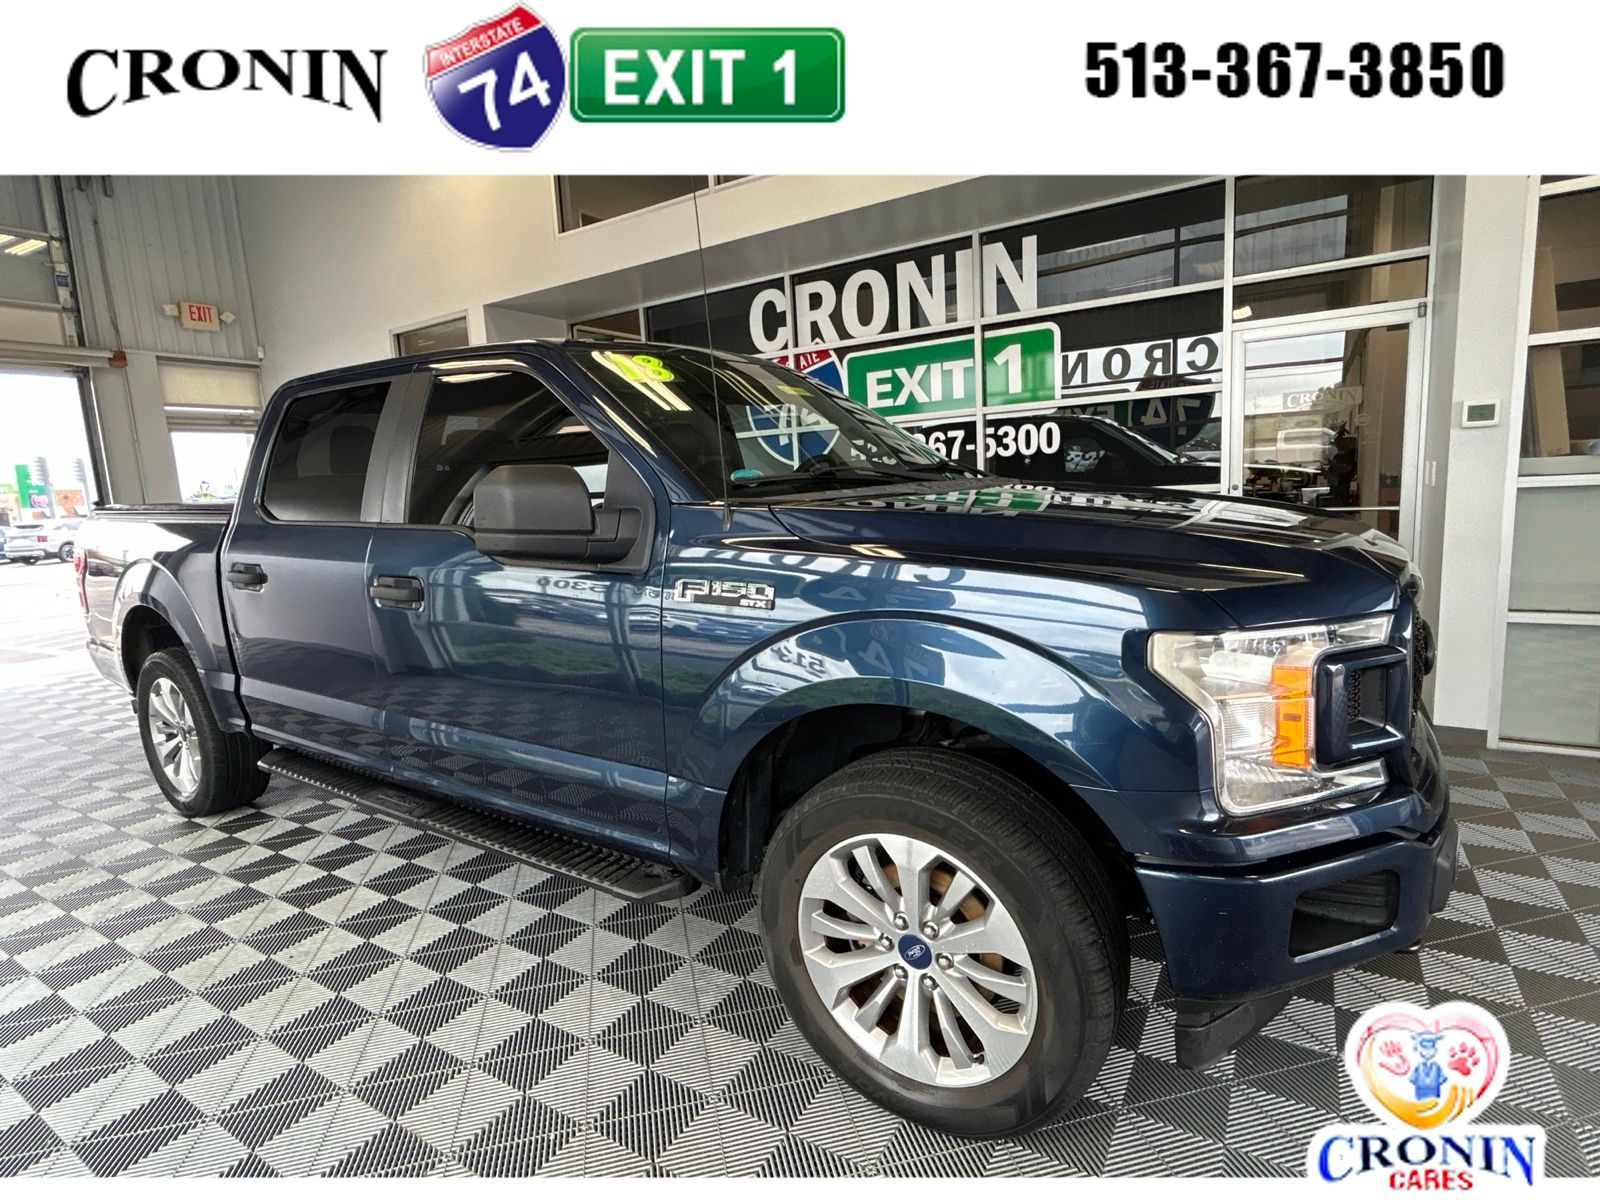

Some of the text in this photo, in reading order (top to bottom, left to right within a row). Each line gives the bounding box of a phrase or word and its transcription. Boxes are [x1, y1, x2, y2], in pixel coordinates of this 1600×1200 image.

[189, 304, 213, 323] EXIT
[749, 235, 1039, 353] CRONIN
[866, 343, 1024, 409] EXIT 1
[739, 598, 767, 608] STX
